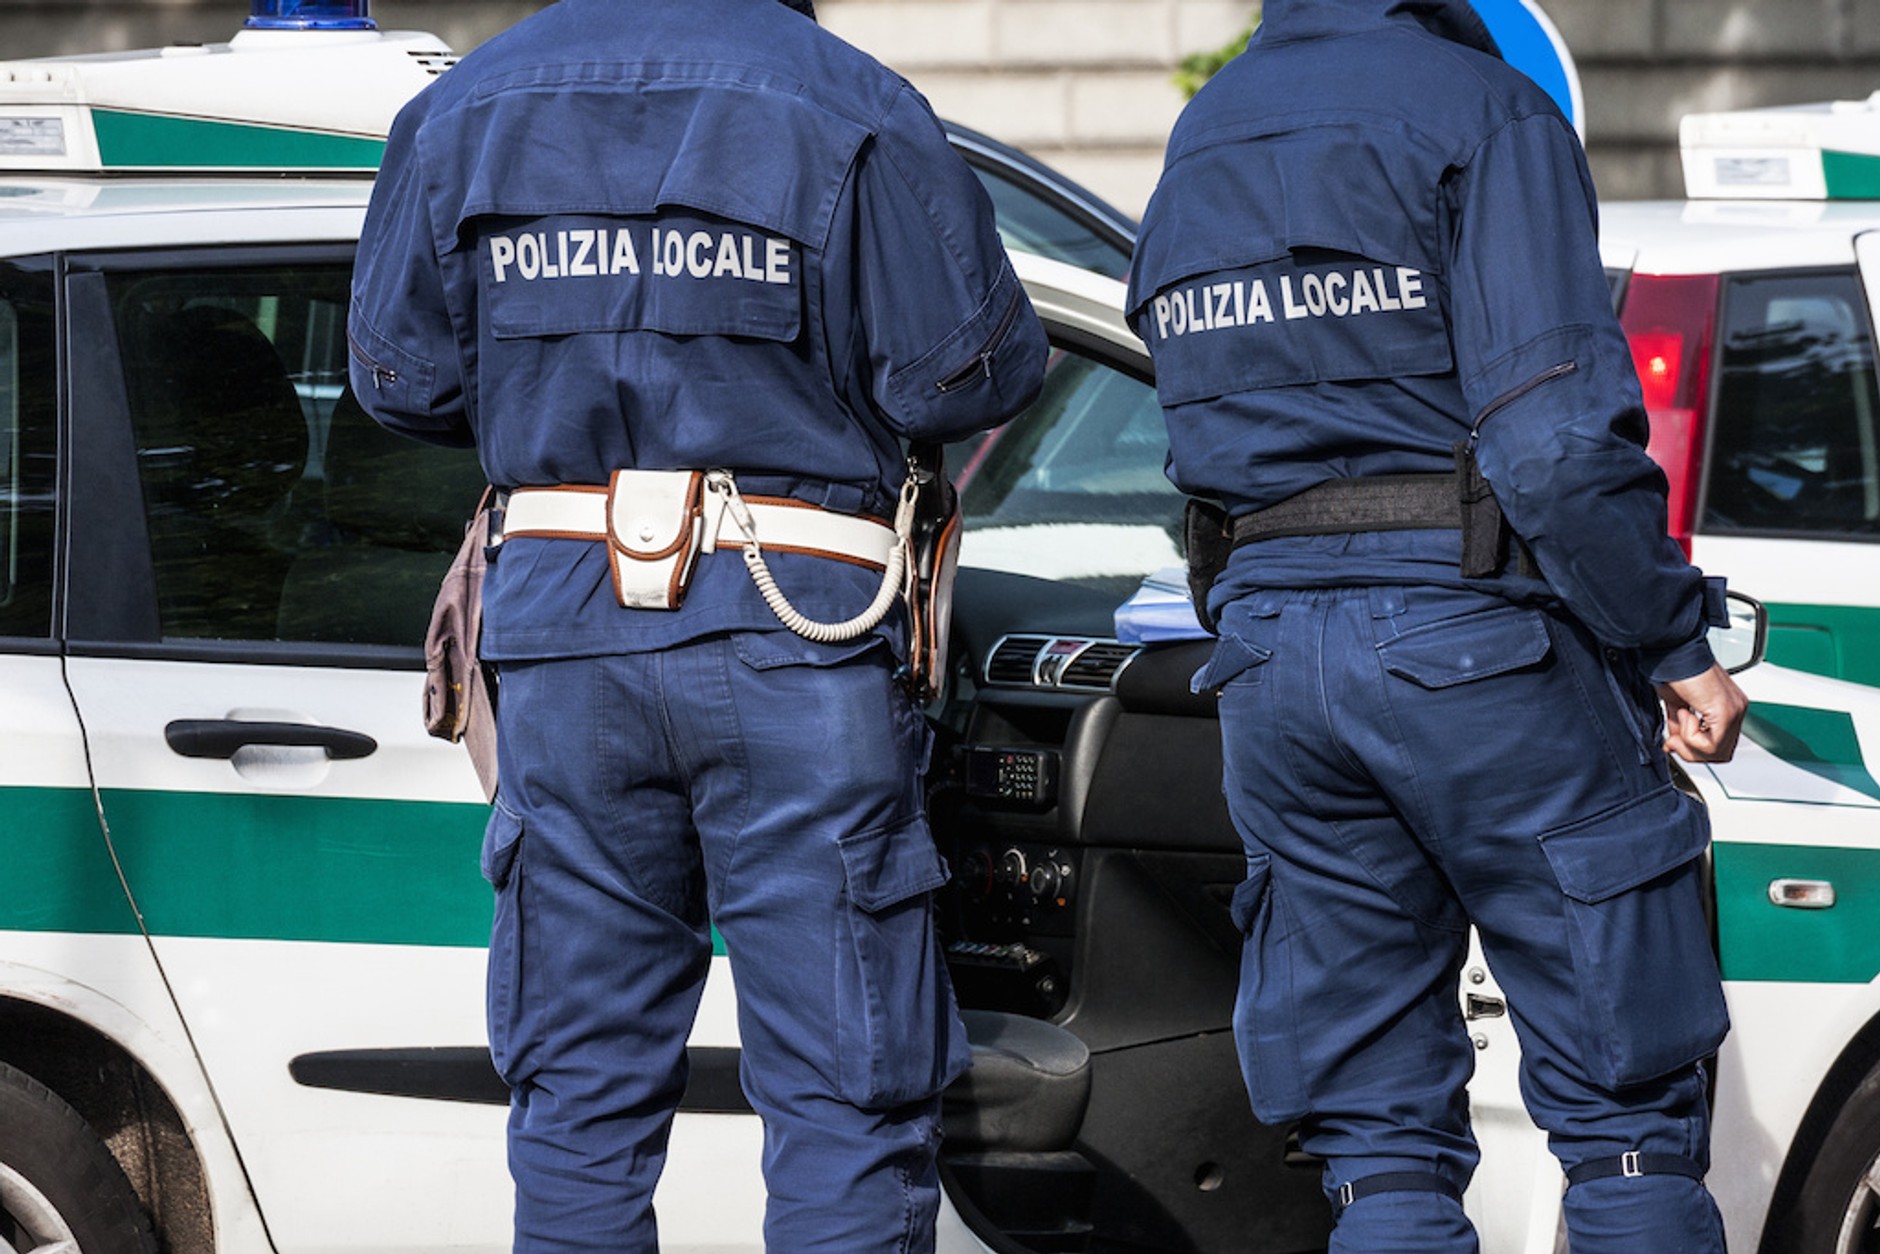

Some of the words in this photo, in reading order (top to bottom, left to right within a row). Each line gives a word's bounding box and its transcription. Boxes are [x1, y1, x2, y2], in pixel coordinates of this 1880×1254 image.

[490, 229, 640, 282] POLIZIA
[653, 228, 790, 283] LOCALE
[1154, 279, 1275, 339] POLIZIA
[1279, 266, 1427, 319] LOCALE
